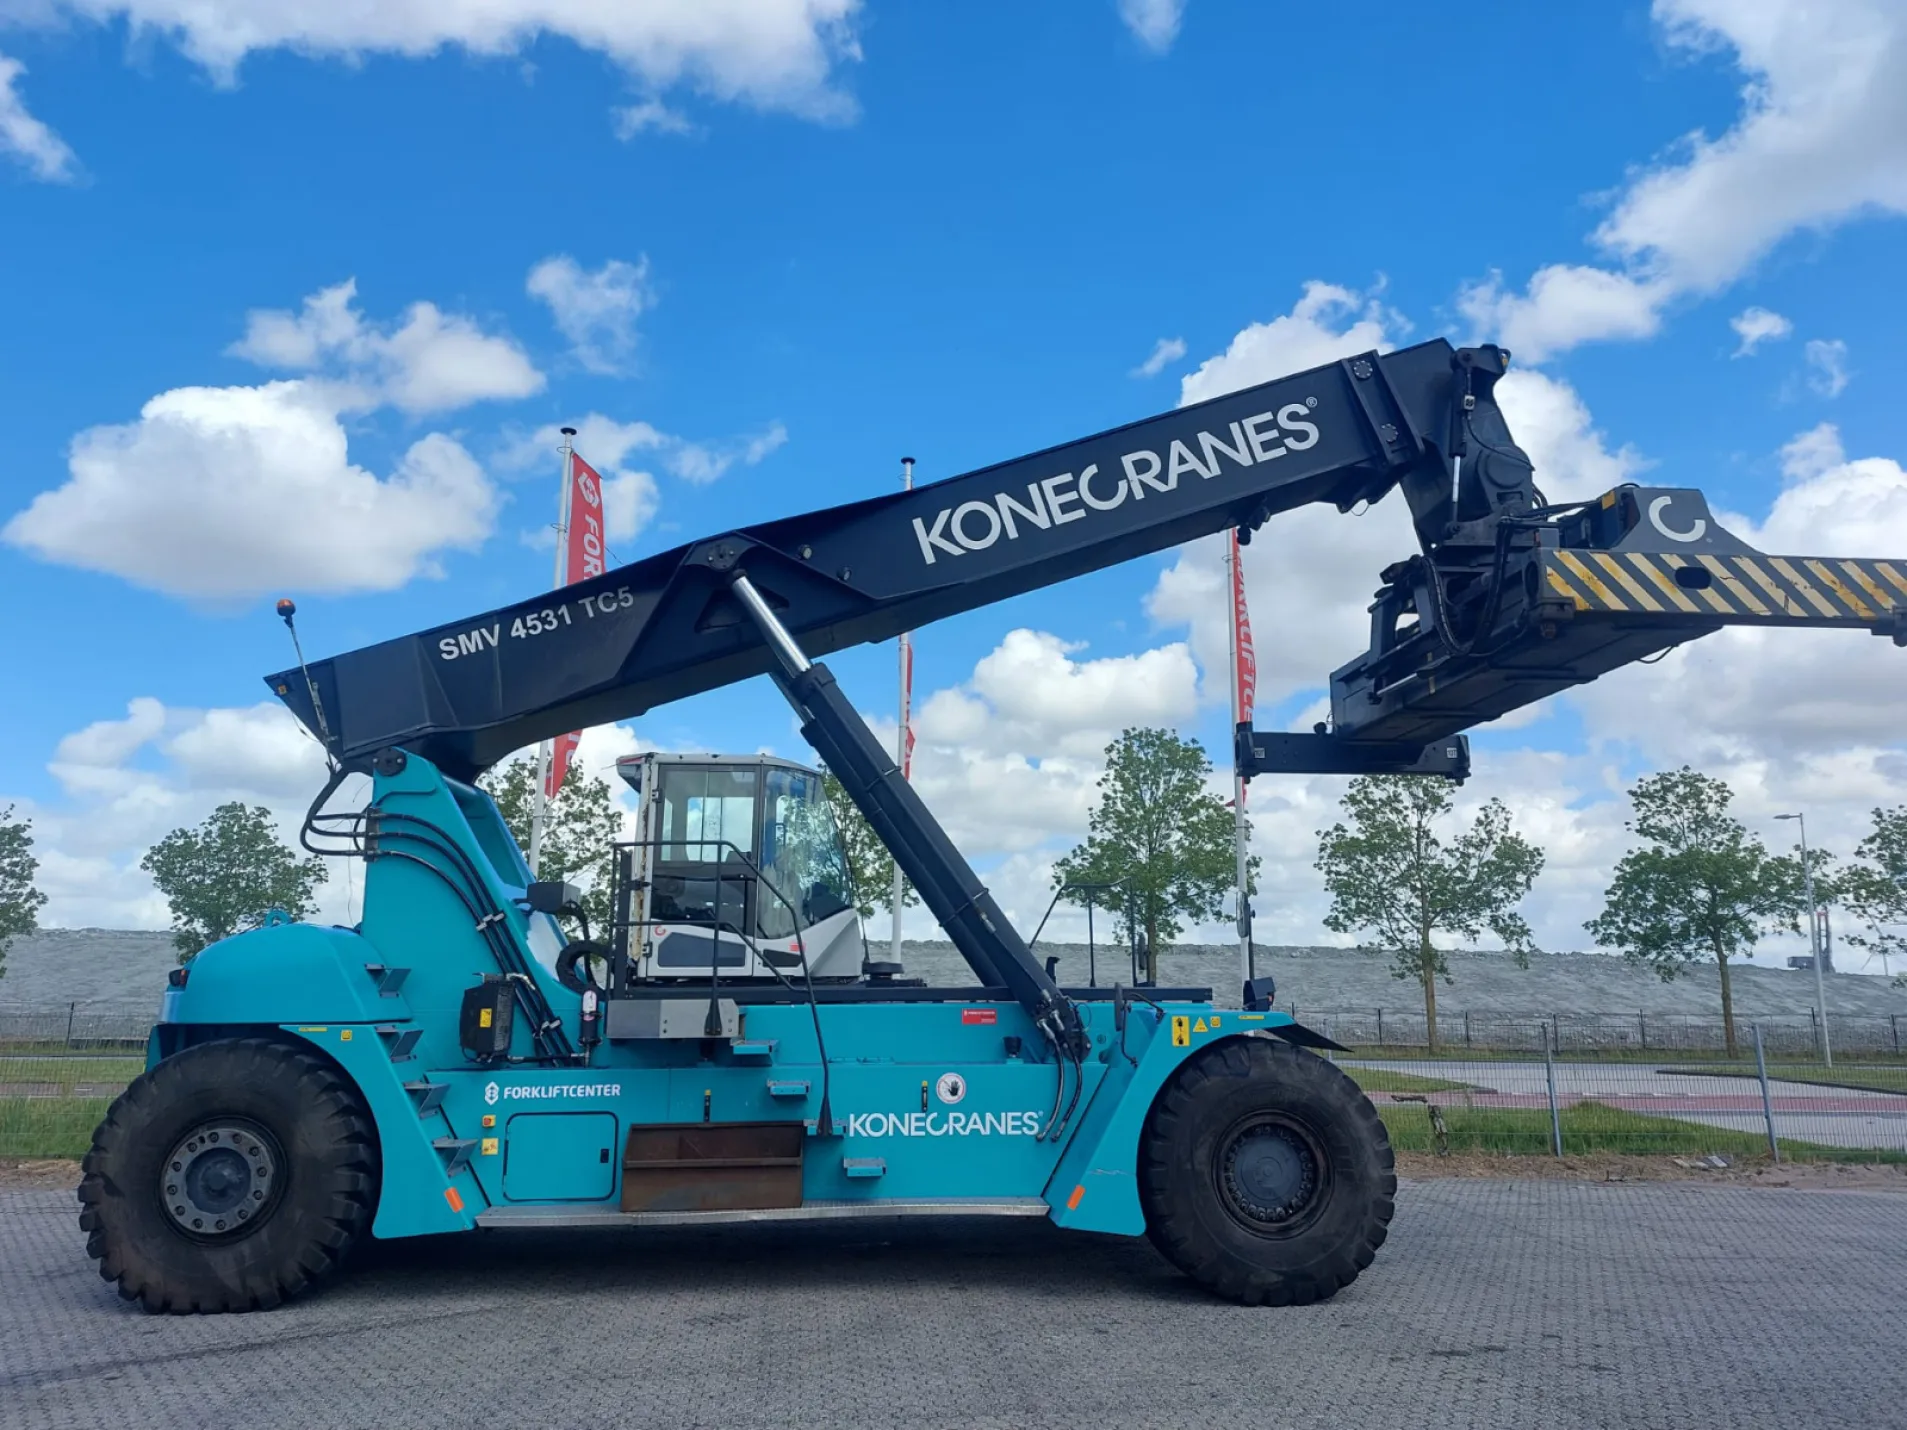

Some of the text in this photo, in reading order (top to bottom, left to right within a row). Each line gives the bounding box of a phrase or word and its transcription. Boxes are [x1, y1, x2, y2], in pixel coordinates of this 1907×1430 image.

[583, 514, 602, 580] FOR
[439, 586, 634, 660] SMV 4531 TC5
[503, 1084, 621, 1100] FORKLIFTCENTER
